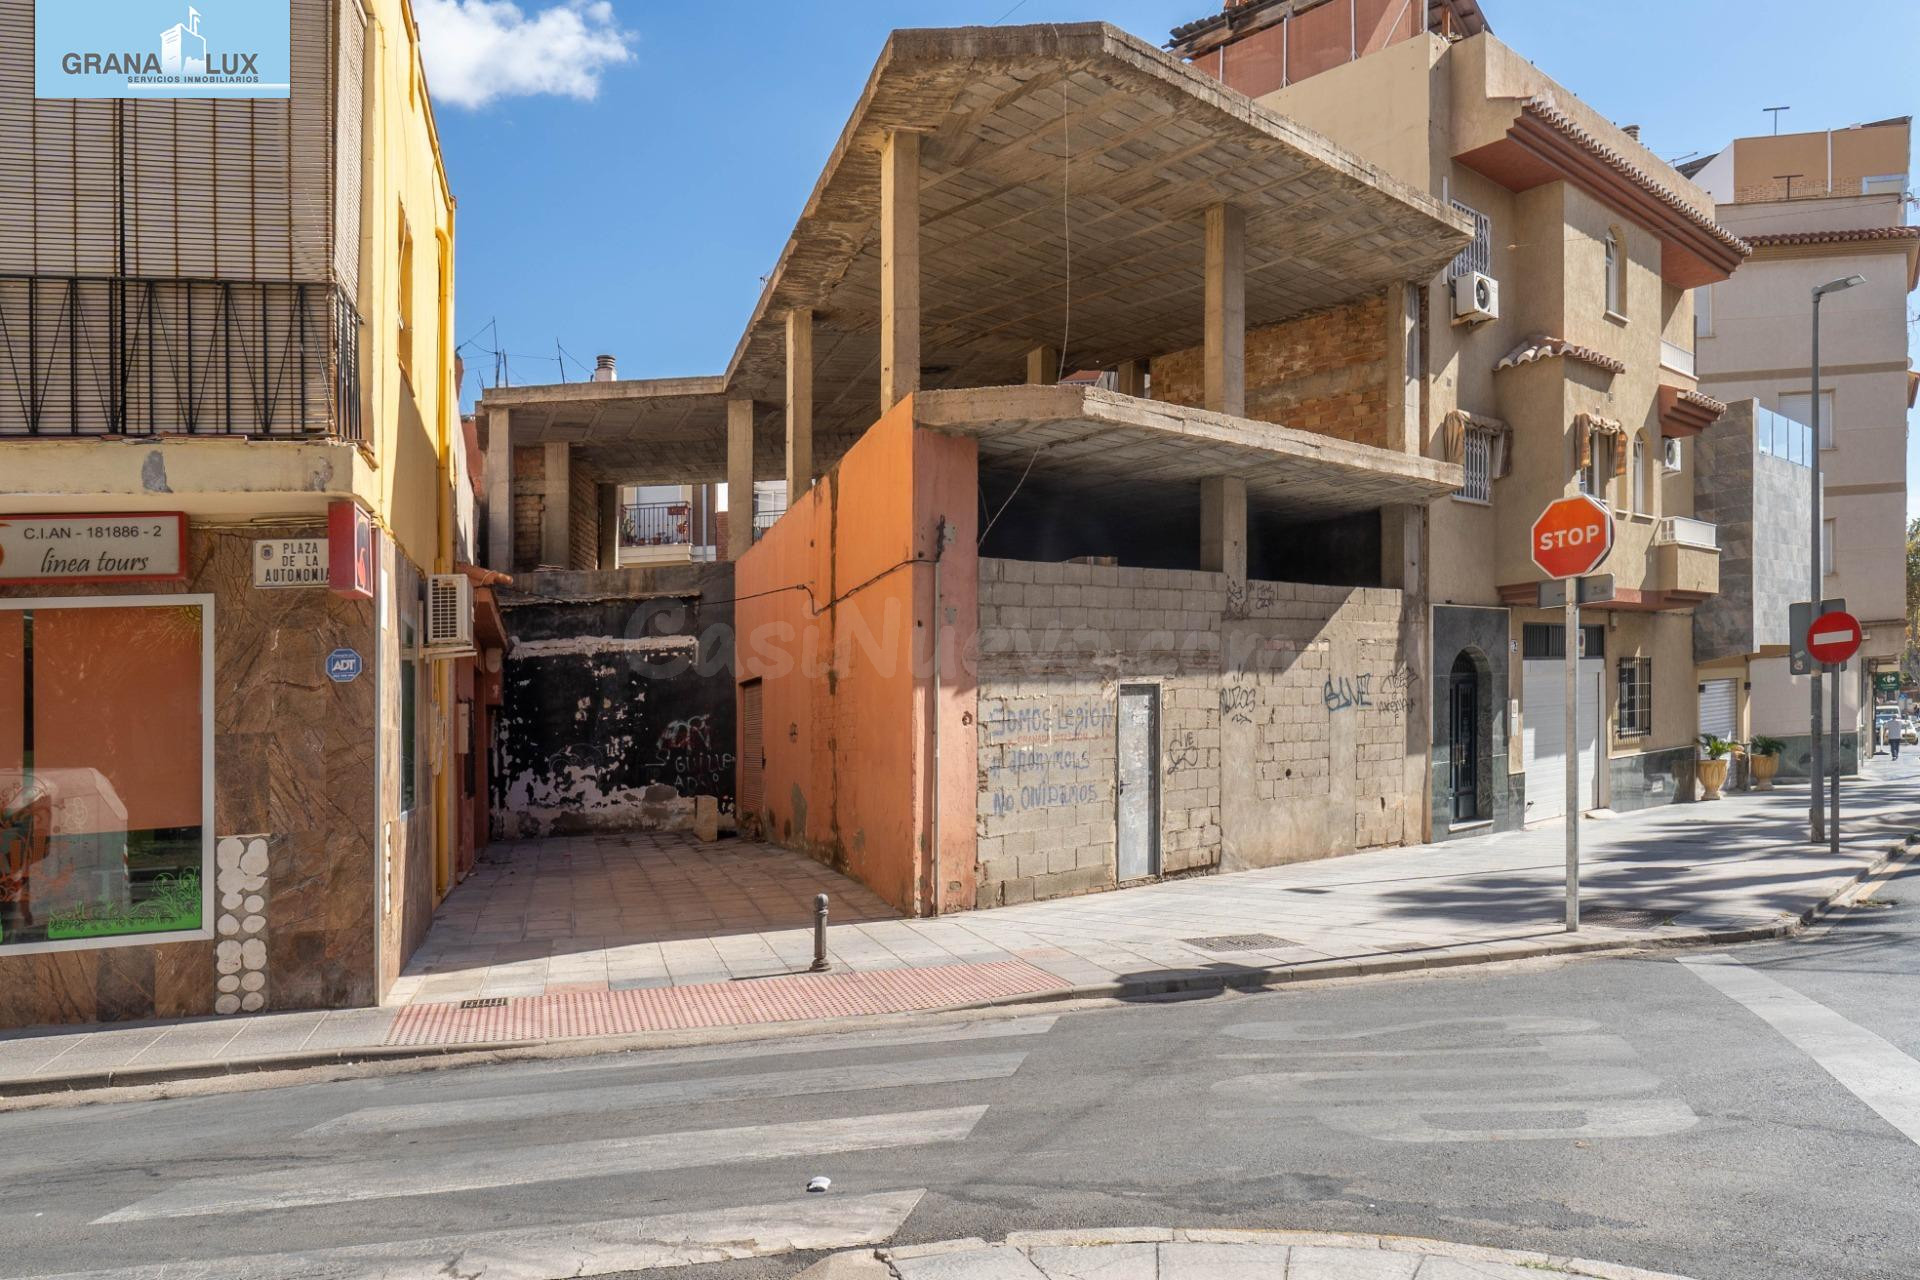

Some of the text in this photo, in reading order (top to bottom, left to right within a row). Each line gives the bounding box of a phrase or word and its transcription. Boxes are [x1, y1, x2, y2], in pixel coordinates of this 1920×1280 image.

[87, 526, 139, 538] 181886
[153, 525, 162, 537] 2
[1539, 524, 1600, 551] STOP
[282, 542, 318, 555] PLAZA
[96, 551, 149, 572] tours
[281, 555, 319, 567] DE LA
[332, 659, 355, 671] ADT
